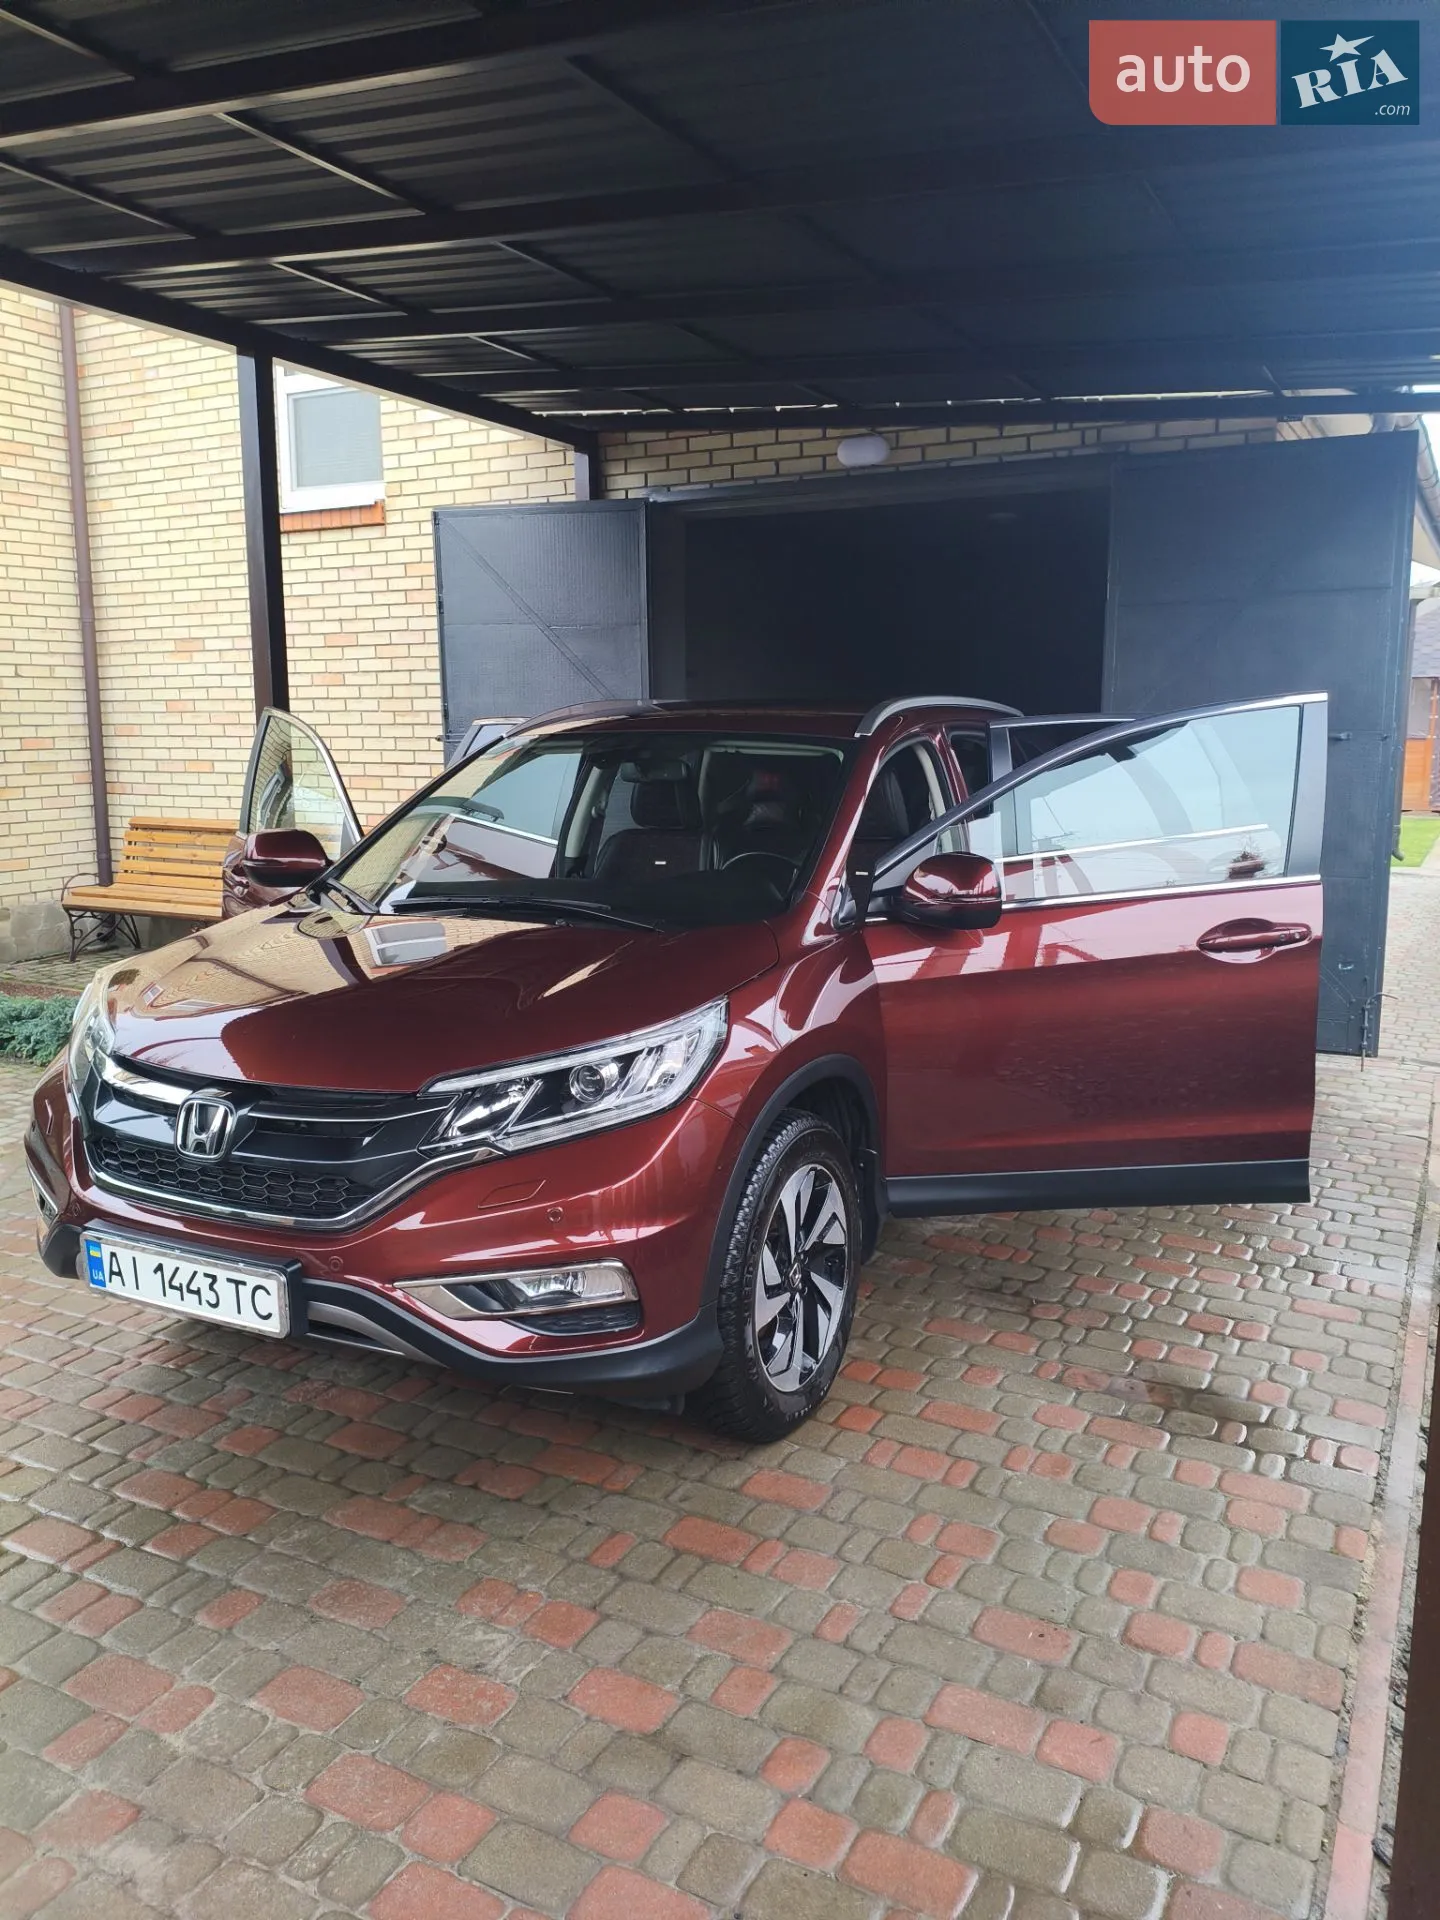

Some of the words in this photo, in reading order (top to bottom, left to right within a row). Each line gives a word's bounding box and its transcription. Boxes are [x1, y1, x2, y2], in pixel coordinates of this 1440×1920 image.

[92, 1268, 105, 1283] UA
[108, 1251, 140, 1291] AI
[152, 1262, 221, 1309] 1443
[226, 1277, 273, 1321] TC
